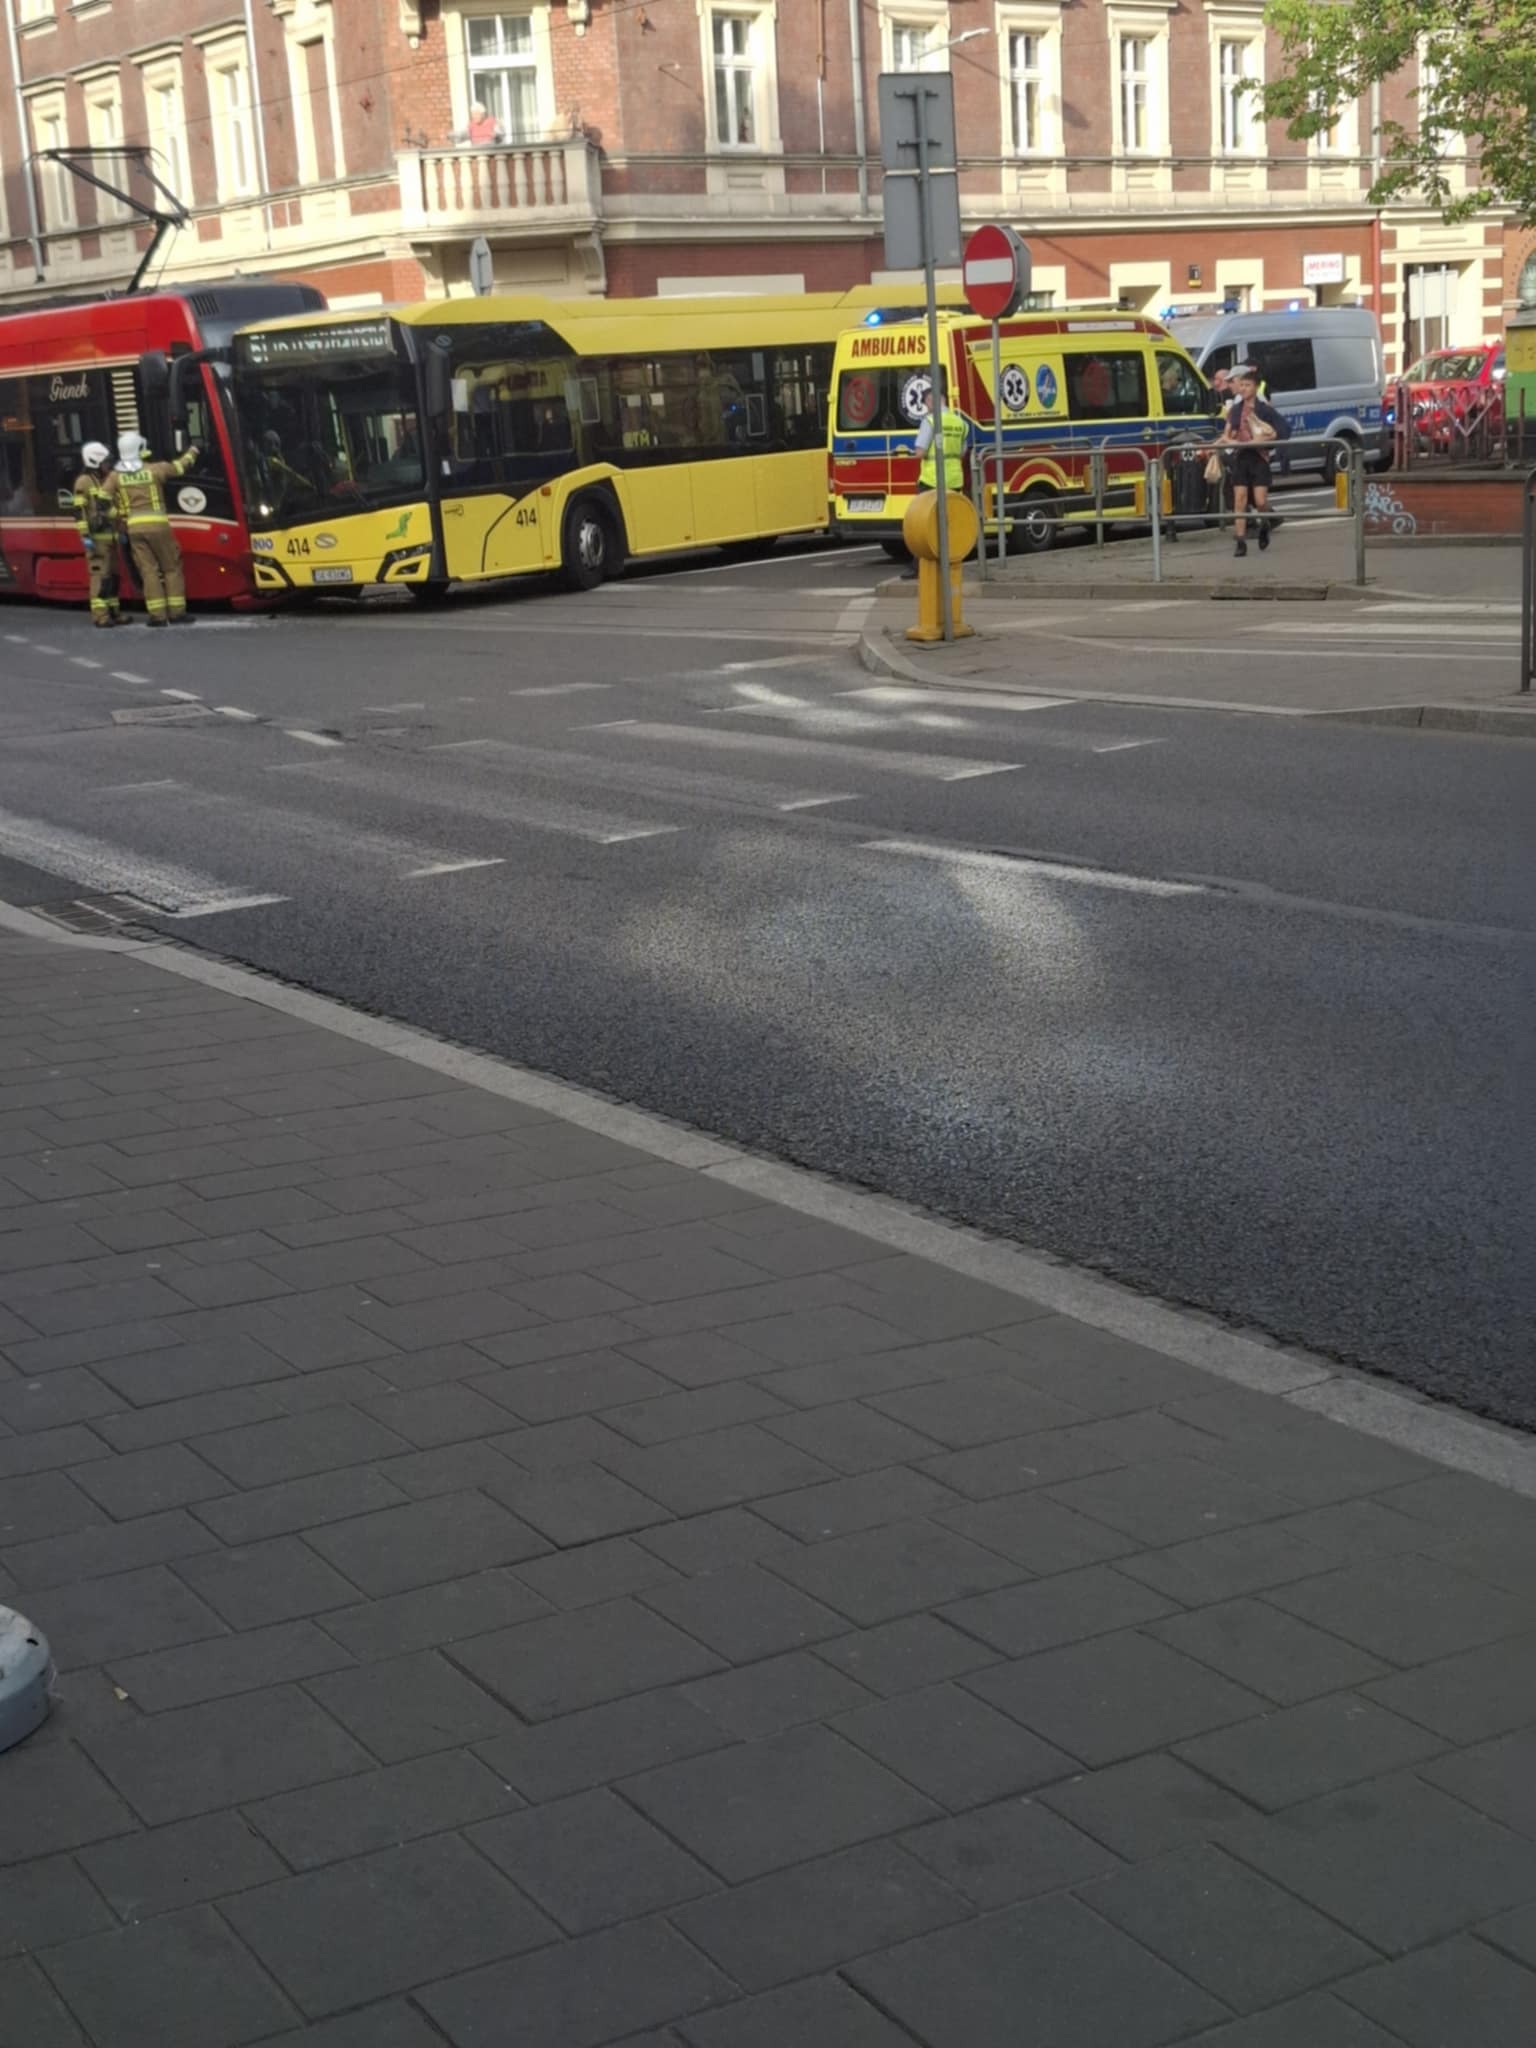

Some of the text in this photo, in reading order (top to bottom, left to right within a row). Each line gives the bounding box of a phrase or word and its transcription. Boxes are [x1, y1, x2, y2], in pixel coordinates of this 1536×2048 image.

[851, 335, 926, 358] AMBULANS
[516, 508, 538, 527] 414
[287, 538, 311, 556] 414
